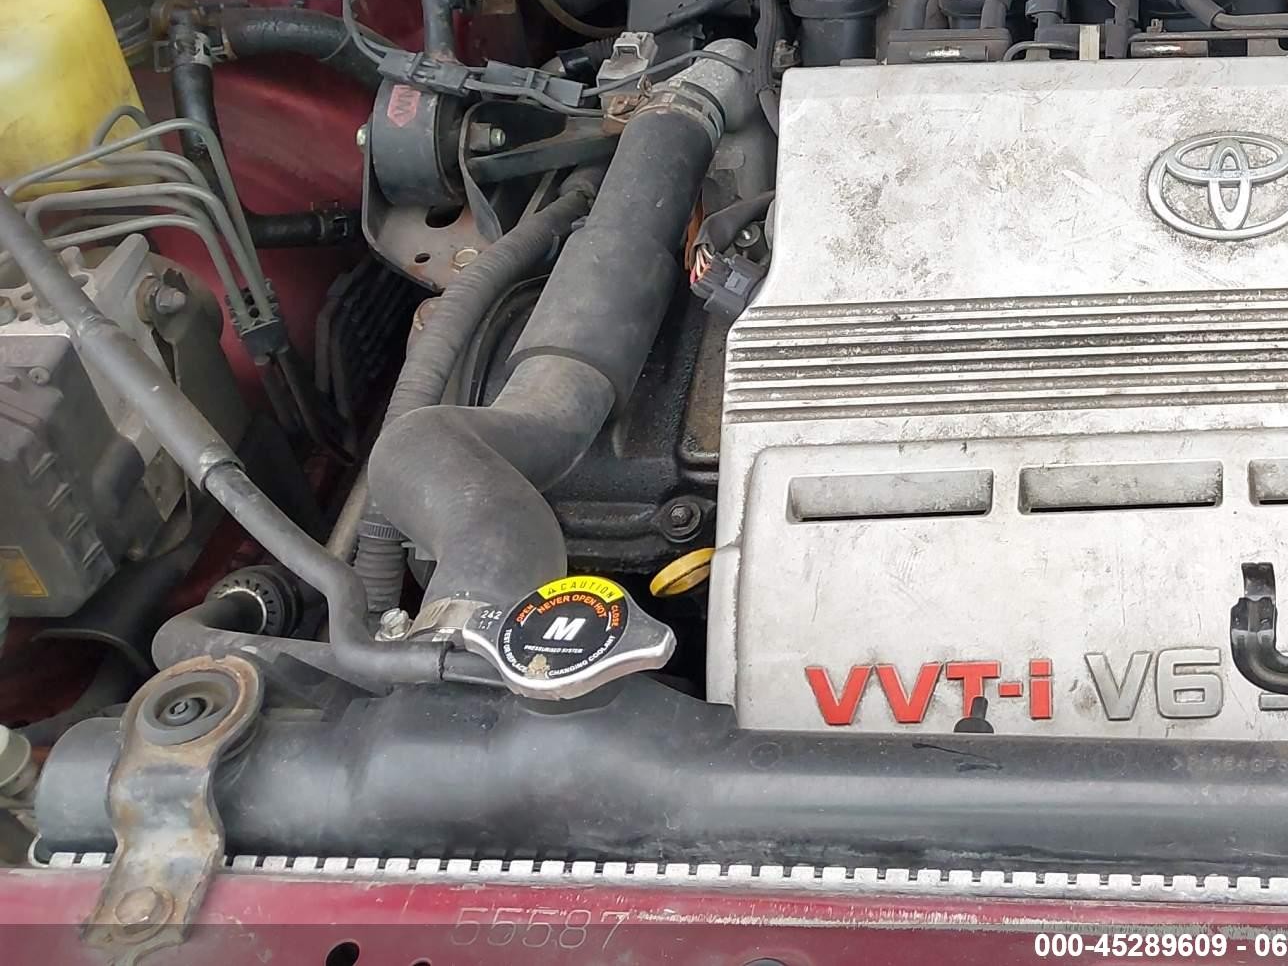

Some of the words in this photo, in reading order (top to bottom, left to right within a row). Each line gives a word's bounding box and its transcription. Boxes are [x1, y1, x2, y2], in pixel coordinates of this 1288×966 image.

[560, 580, 615, 599] CAUTION
[516, 603, 534, 622] OPEN
[537, 595, 570, 614] NEVER
[572, 593, 596, 606] OPEN
[594, 600, 607, 618] HOT
[610, 604, 620, 627] CLOSE
[503, 628, 512, 643] TEST
[543, 617, 587, 641] M
[548, 659, 589, 676] CHANGING
[588, 634, 616, 662] COOLANT
[804, 657, 1054, 727] VVT-i
[1084, 646, 1224, 721] V6
[450, 906, 630, 951] 55587
